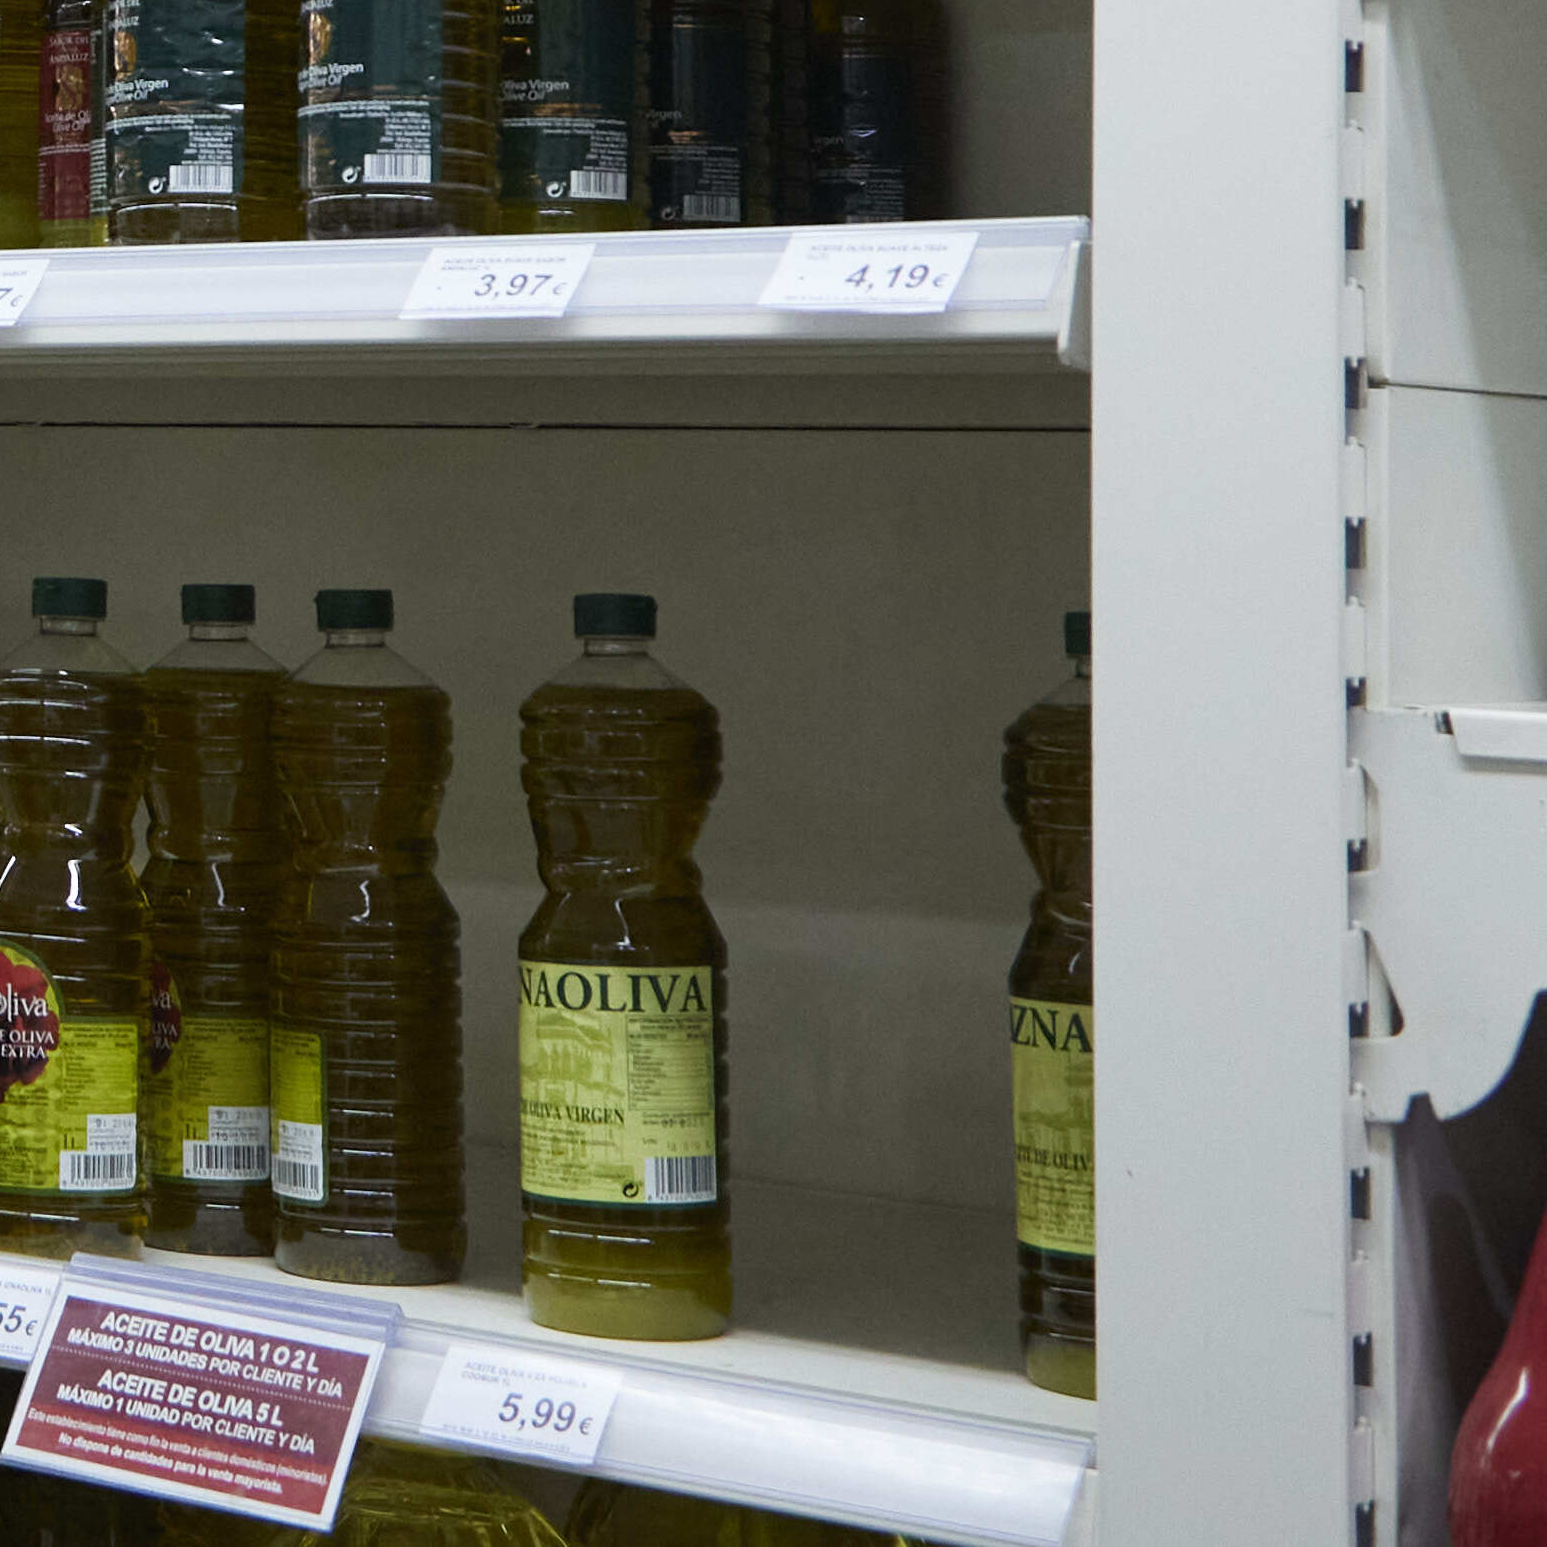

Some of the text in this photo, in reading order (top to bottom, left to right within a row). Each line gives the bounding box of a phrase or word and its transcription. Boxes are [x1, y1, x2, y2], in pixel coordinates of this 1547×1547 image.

[136, 77, 169, 93] Virgen
[328, 62, 364, 78] Virgen
[528, 79, 569, 94] Virgen
[528, 89, 545, 101] Oil
[520, 966, 707, 1013] NAOLIVA
[1, 1044, 46, 1059] EXTRA
[9, 1028, 55, 1045] OLIVA
[565, 1106, 626, 1125] VIRGEN
[100, 1311, 319, 1374] ACEITE DE OLIVA 1 O 2 L
[67, 1327, 343, 1398] MÁXIMO 3 UNIDADES POR CLIENTE Y DÍA
[97, 1369, 284, 1427] ACEITE DE OLIVA 5 L
[28, 1407, 228, 1463] Este establecimiento tiene como venta clientes
[57, 1384, 315, 1454] MÁXIMO 1 UNIDAD POR CLIENTE Y DÍA
[59, 1431, 282, 1495] No dispone de cantidades para la venta mayorista.
